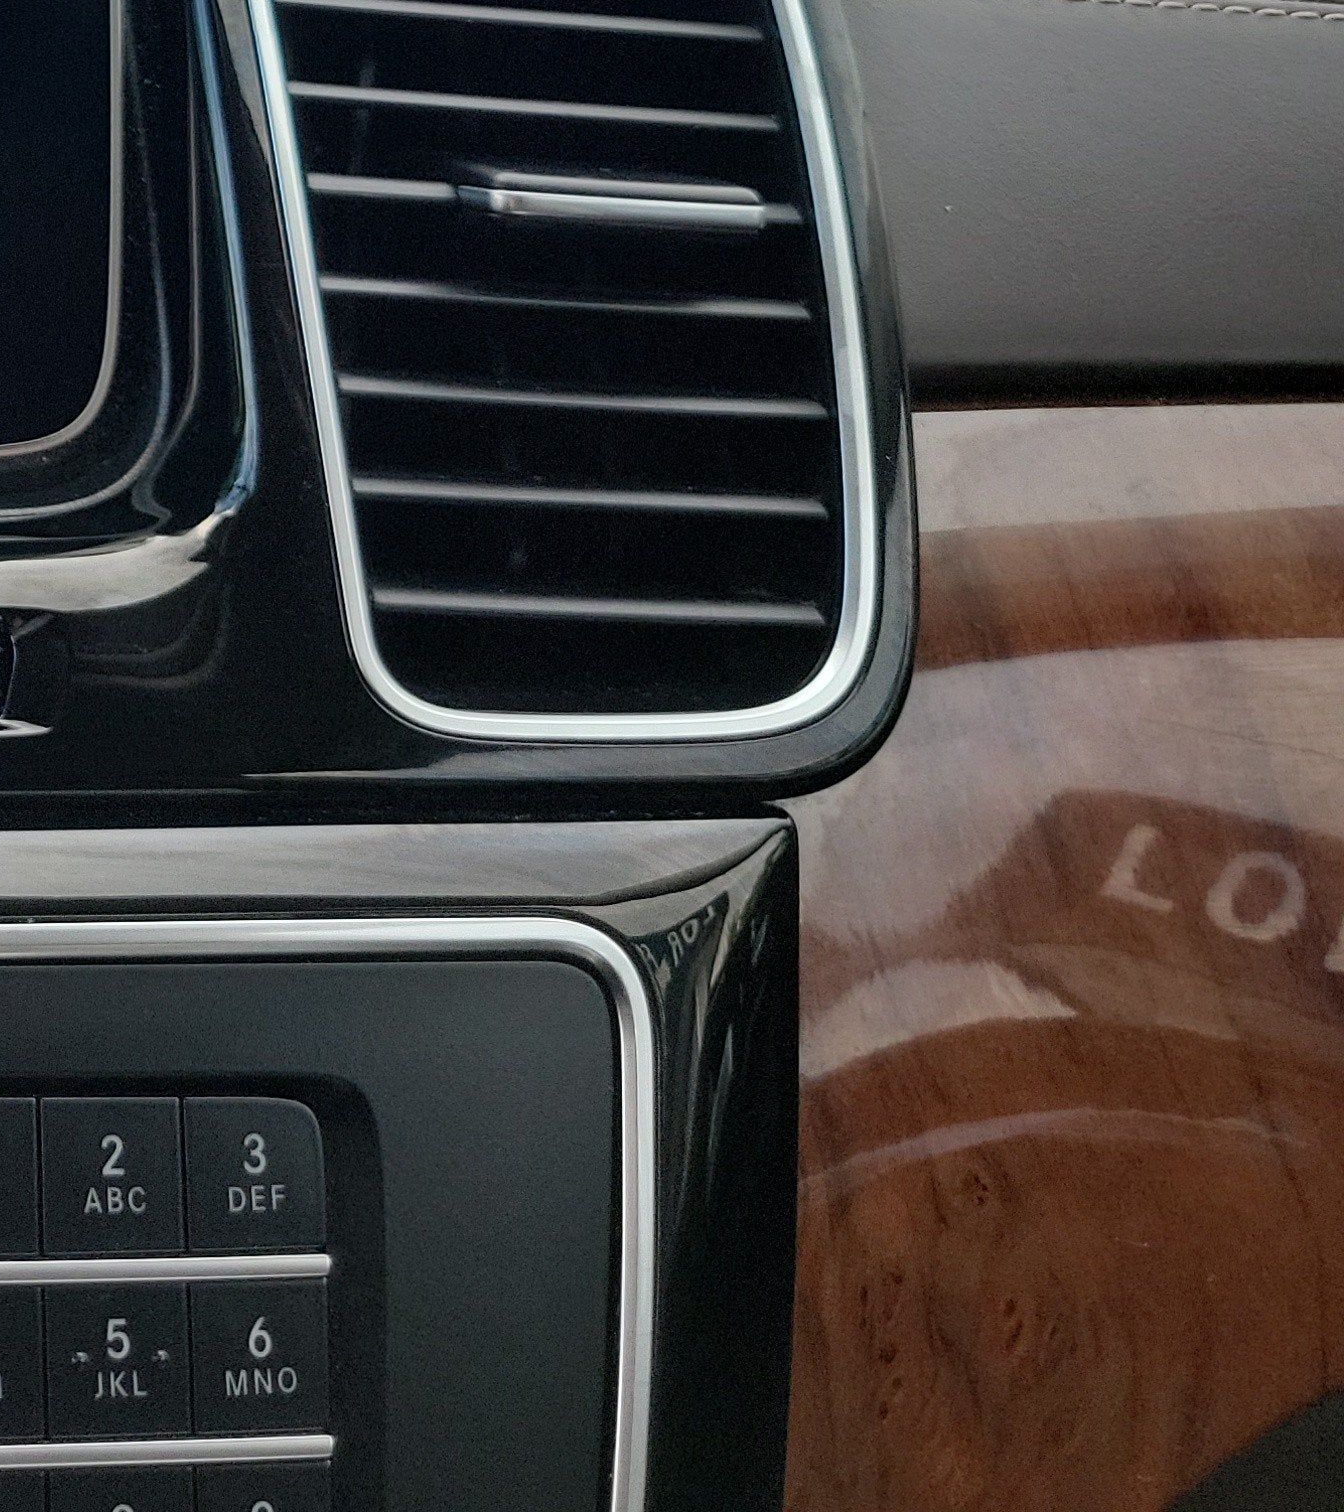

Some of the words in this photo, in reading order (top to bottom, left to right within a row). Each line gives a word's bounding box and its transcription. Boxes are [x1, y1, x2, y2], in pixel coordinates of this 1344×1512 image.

[100, 1135, 126, 1176] 2
[243, 1133, 267, 1175] 3
[84, 1186, 147, 1214] ABC
[228, 1185, 286, 1212] DEF
[106, 1318, 130, 1359] 5
[248, 1317, 272, 1359] 6
[94, 1370, 148, 1398] JKL
[225, 1367, 297, 1396] MNO
